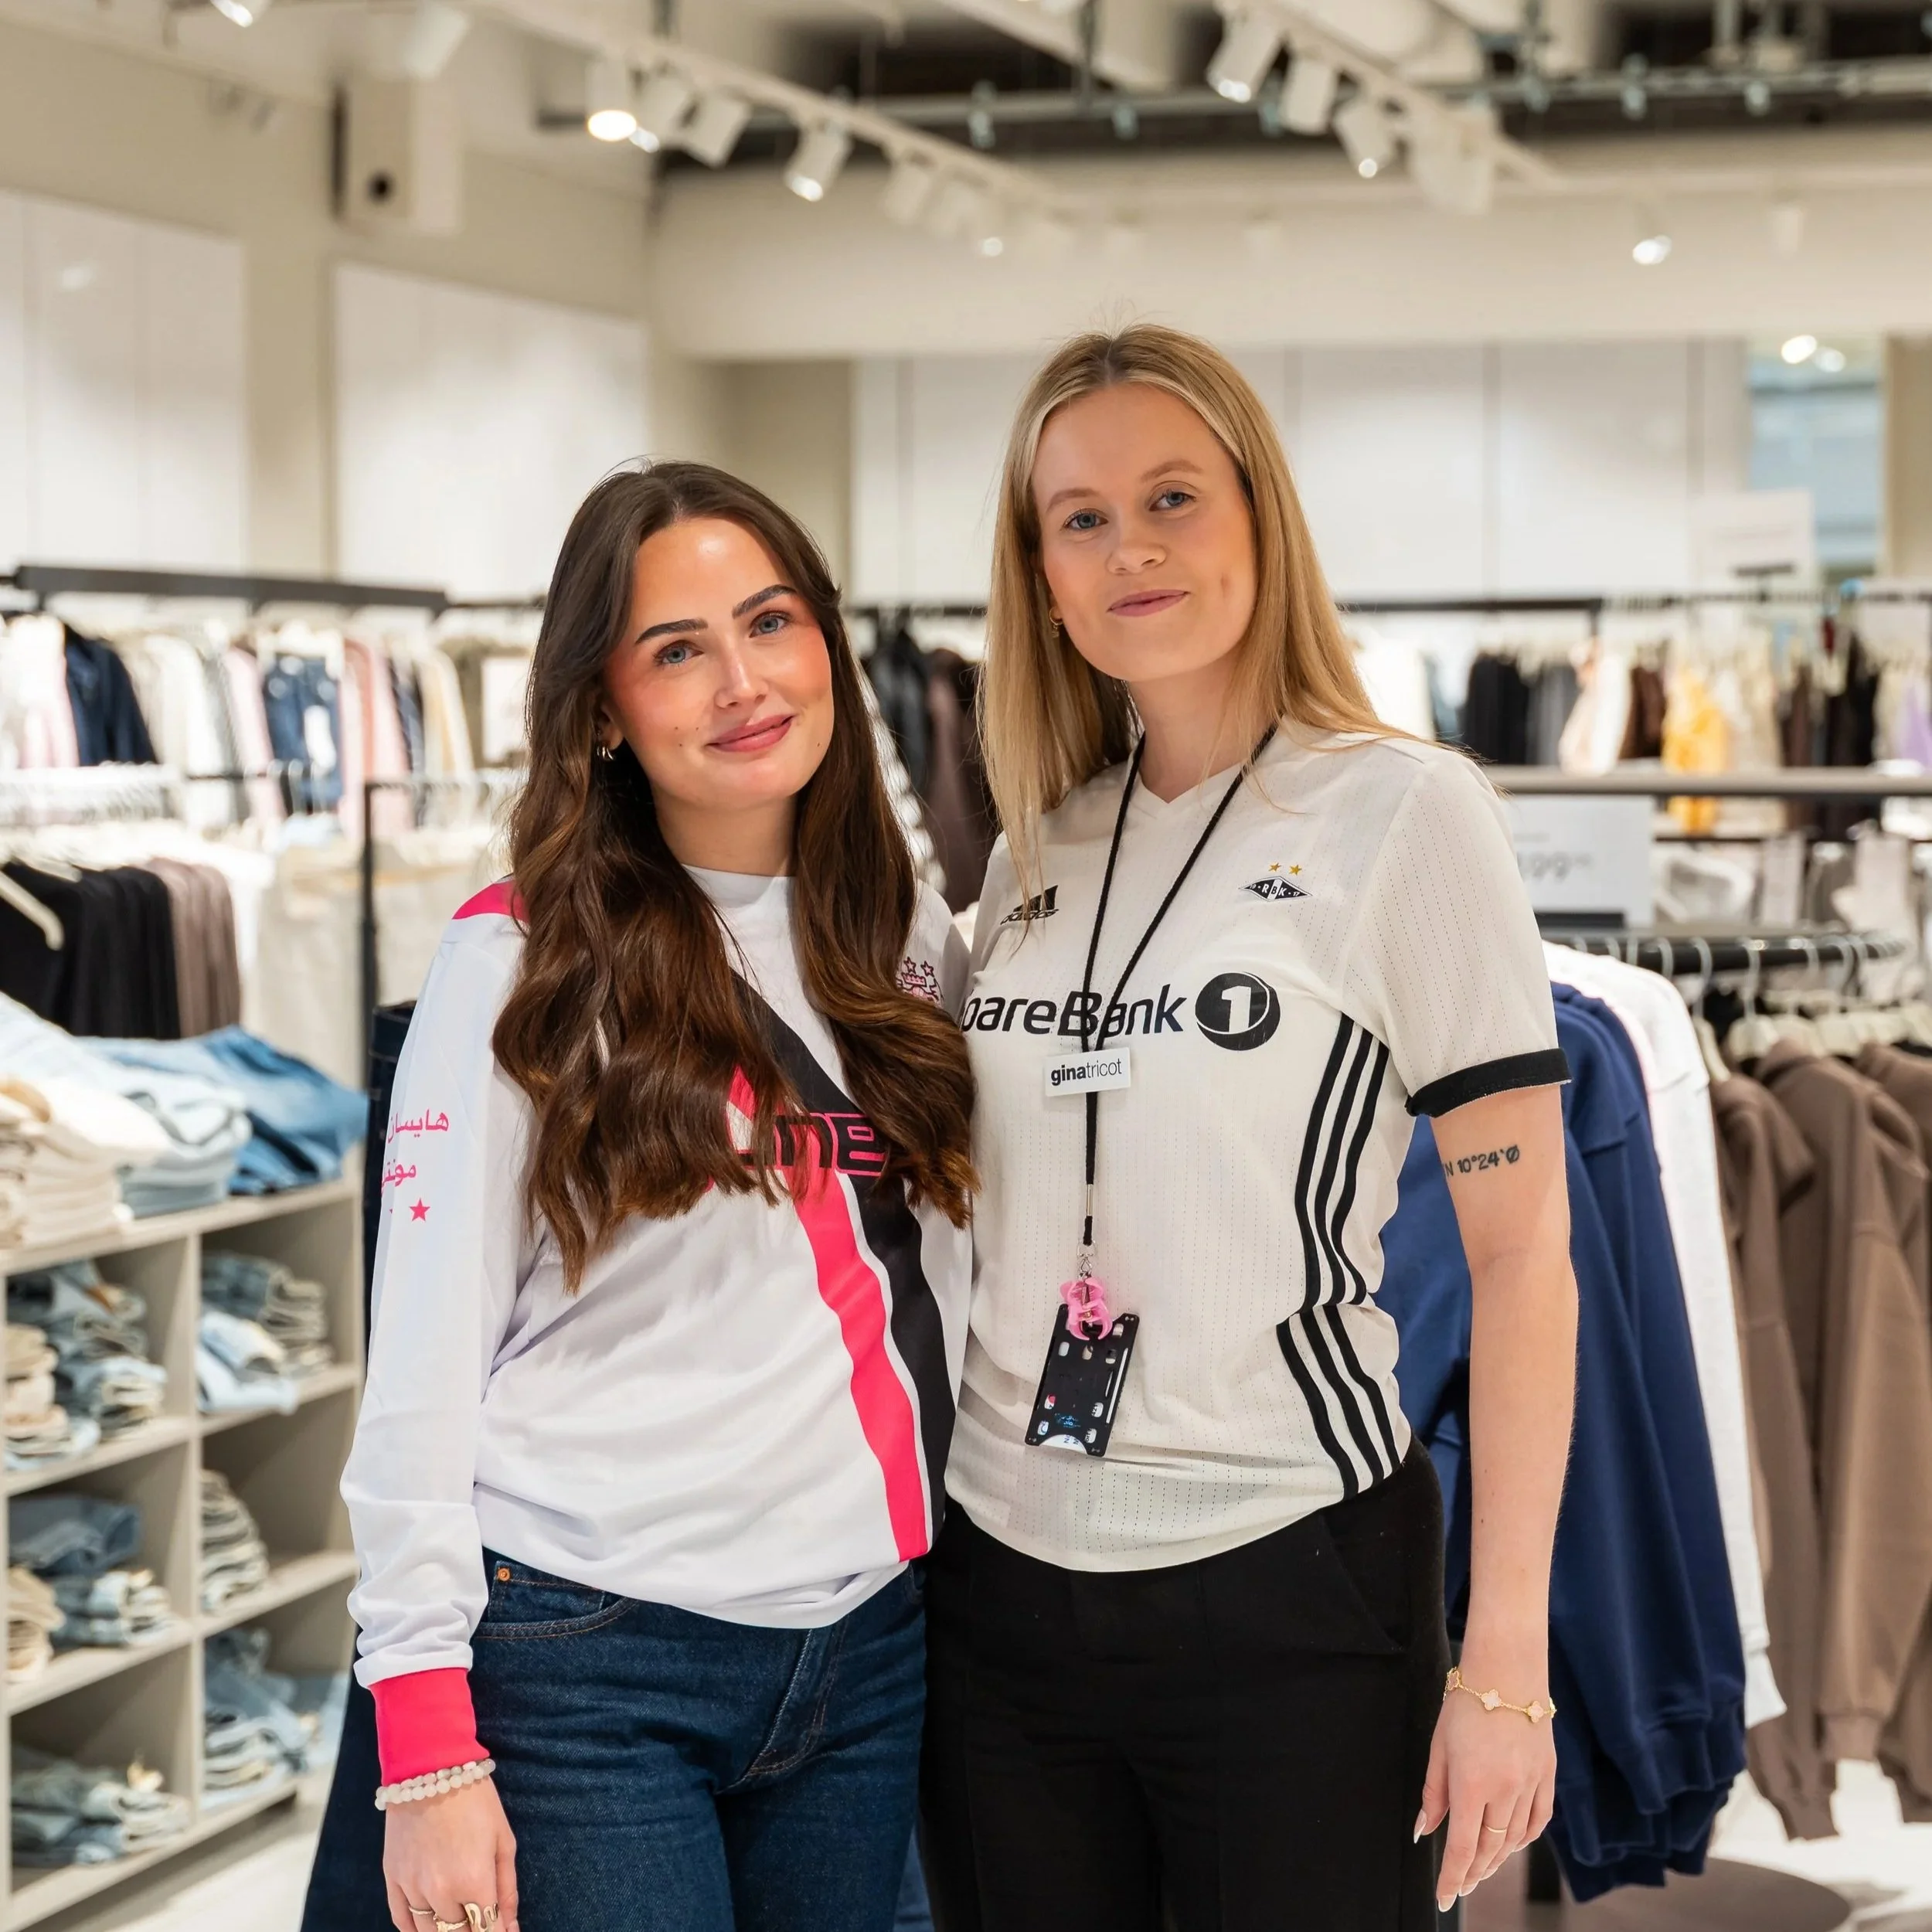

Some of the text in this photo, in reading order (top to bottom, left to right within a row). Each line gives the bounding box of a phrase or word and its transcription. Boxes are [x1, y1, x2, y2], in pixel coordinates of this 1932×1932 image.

[1261, 883, 1287, 896] RBK
[961, 984, 1187, 1038] pareBank
[1050, 1058, 1122, 1086] ginatricot
